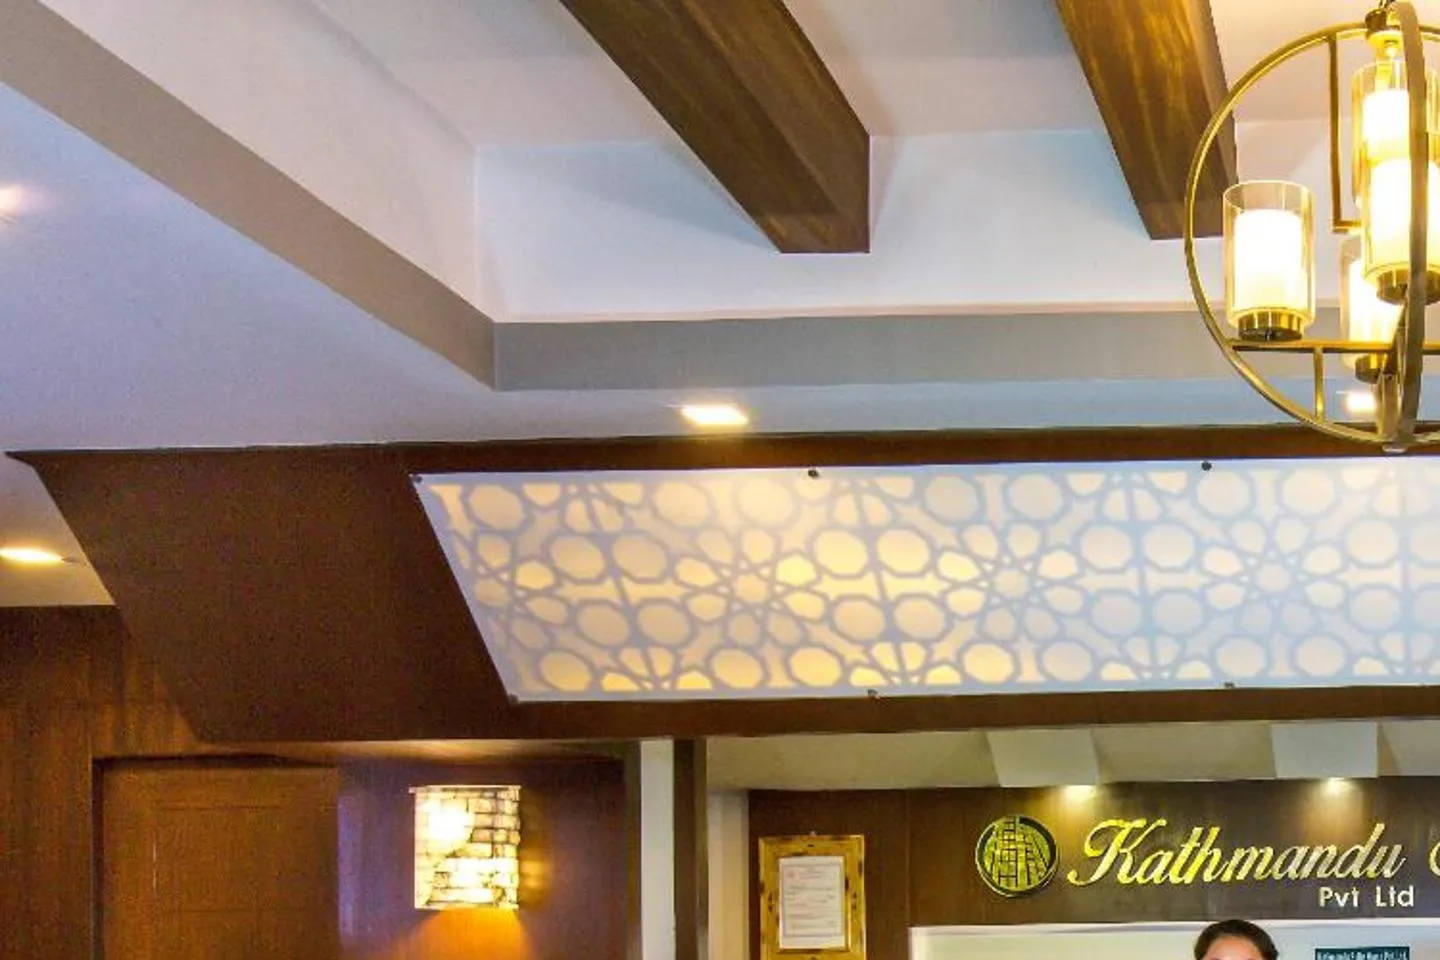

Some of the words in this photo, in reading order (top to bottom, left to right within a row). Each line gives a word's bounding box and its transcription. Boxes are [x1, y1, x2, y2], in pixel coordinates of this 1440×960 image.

[1067, 817, 1407, 887] Kathmandu
[1318, 886, 1360, 908] Pvt
[1375, 884, 1415, 908] Ltd
